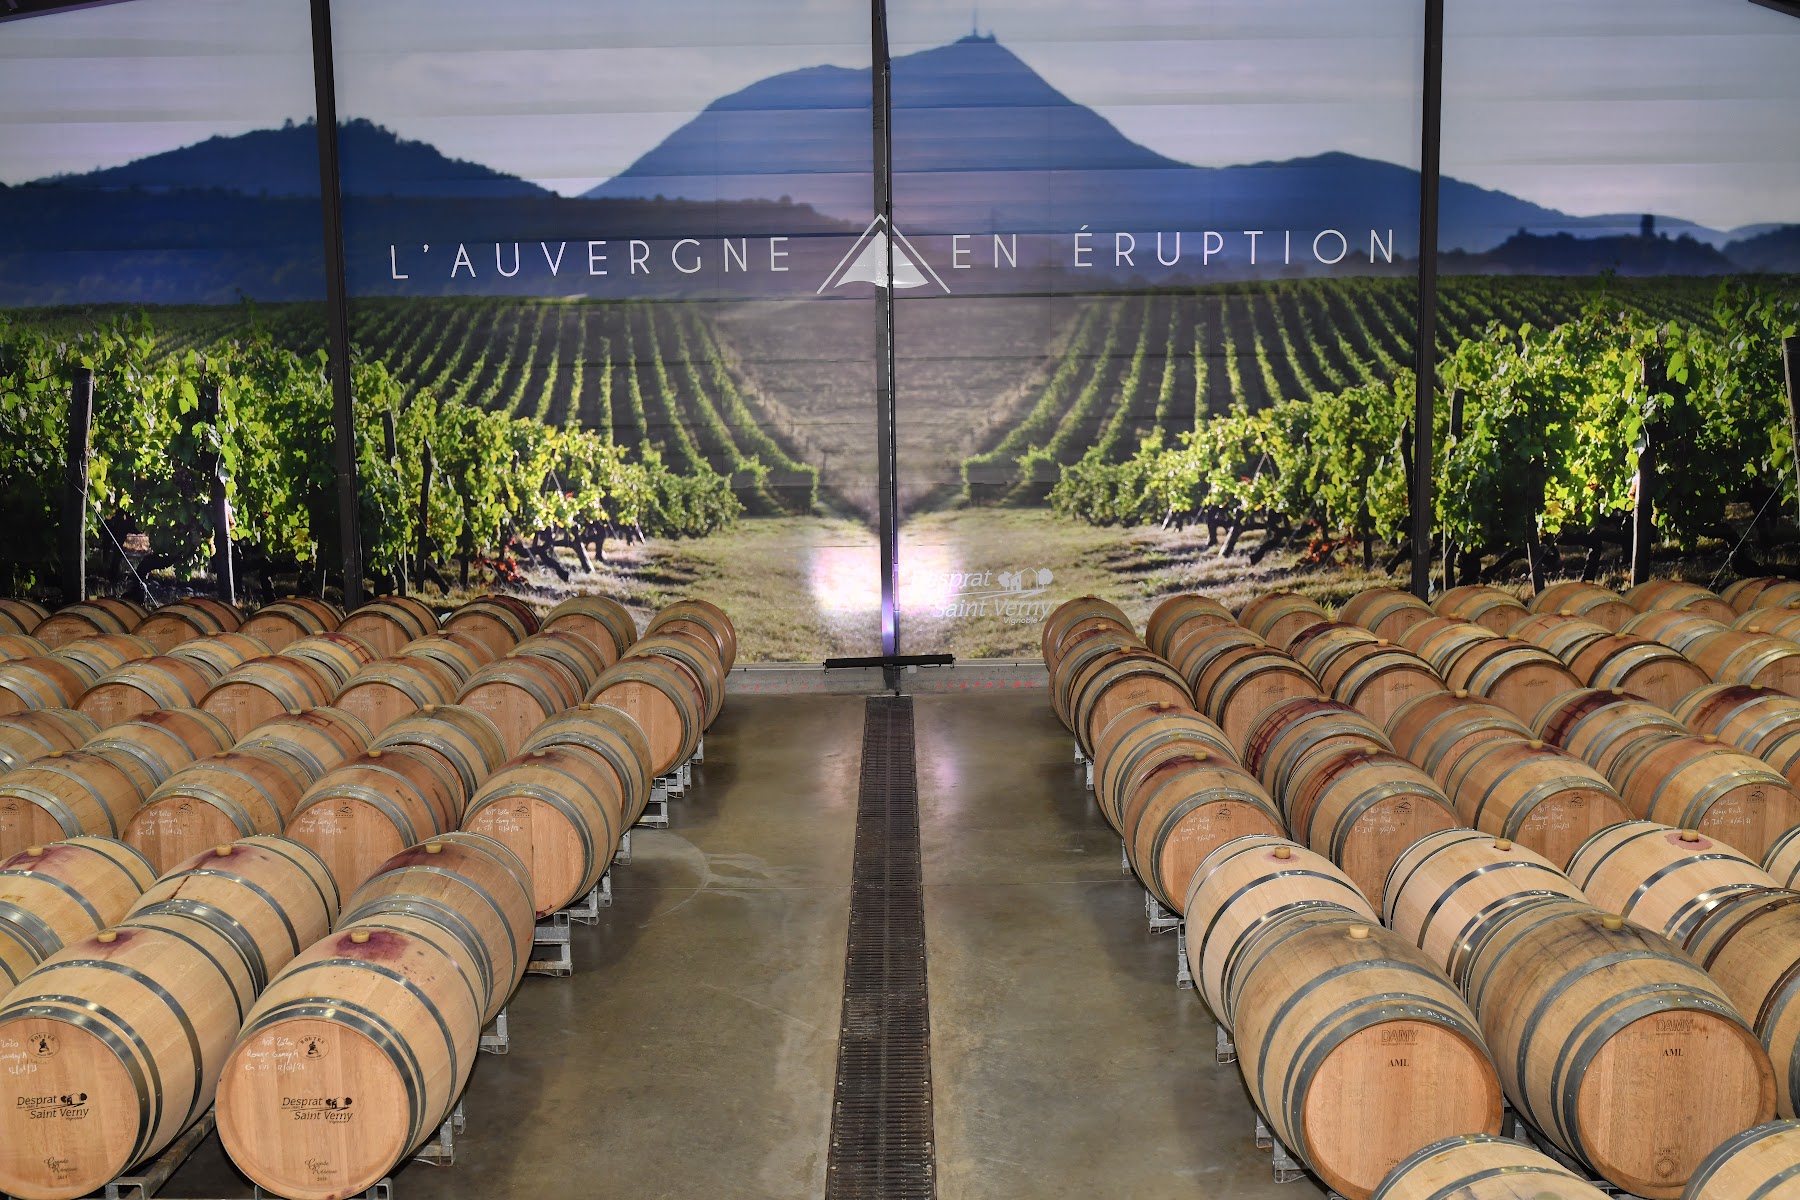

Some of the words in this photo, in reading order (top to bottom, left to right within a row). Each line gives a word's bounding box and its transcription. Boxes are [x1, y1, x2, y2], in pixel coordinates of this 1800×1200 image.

[952, 233, 1018, 269] EN
[1073, 224, 1394, 269] ÉRUPTION
[390, 236, 789, 280] L'AUVERGNE
[912, 569, 992, 592] esprat
[933, 599, 988, 618] Saint
[994, 599, 1053, 622] Verny
[1003, 616, 1039, 626] Vignoble
[1655, 1019, 1694, 1031] DAMY
[1381, 1029, 1419, 1042] DAMY
[1662, 1049, 1684, 1057] AML
[1388, 1058, 1410, 1067] AML
[17, 1095, 57, 1107] Desprat
[282, 1097, 323, 1108] Desprat
[30, 1109, 57, 1119] Saint
[60, 1108, 89, 1118] Verny
[294, 1111, 321, 1120] Saint
[324, 1111, 354, 1123] Verny
